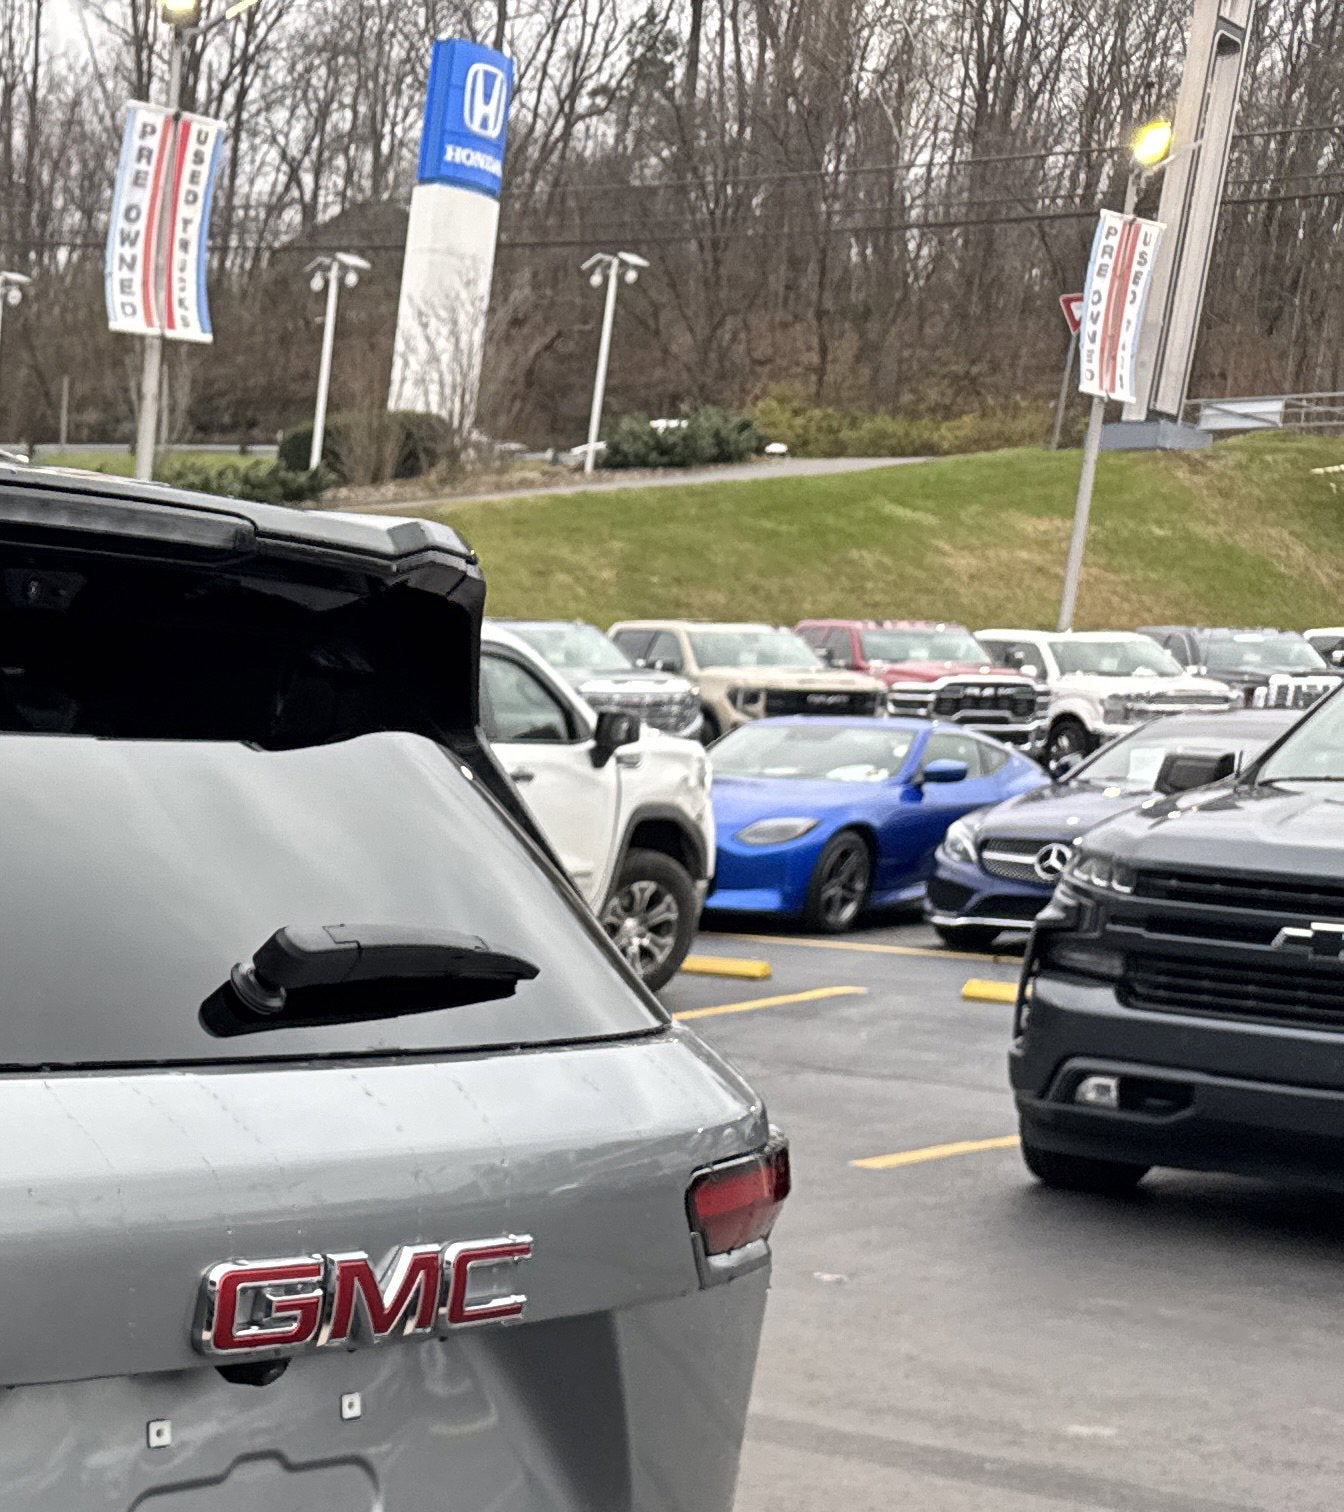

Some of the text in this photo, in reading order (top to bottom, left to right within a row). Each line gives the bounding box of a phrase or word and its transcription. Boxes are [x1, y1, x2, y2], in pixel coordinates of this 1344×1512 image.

[184, 128, 209, 206] USED
[118, 122, 157, 319] PRE OWNED
[1096, 225, 1119, 279] PRE
[194, 1234, 534, 1356] GMC
